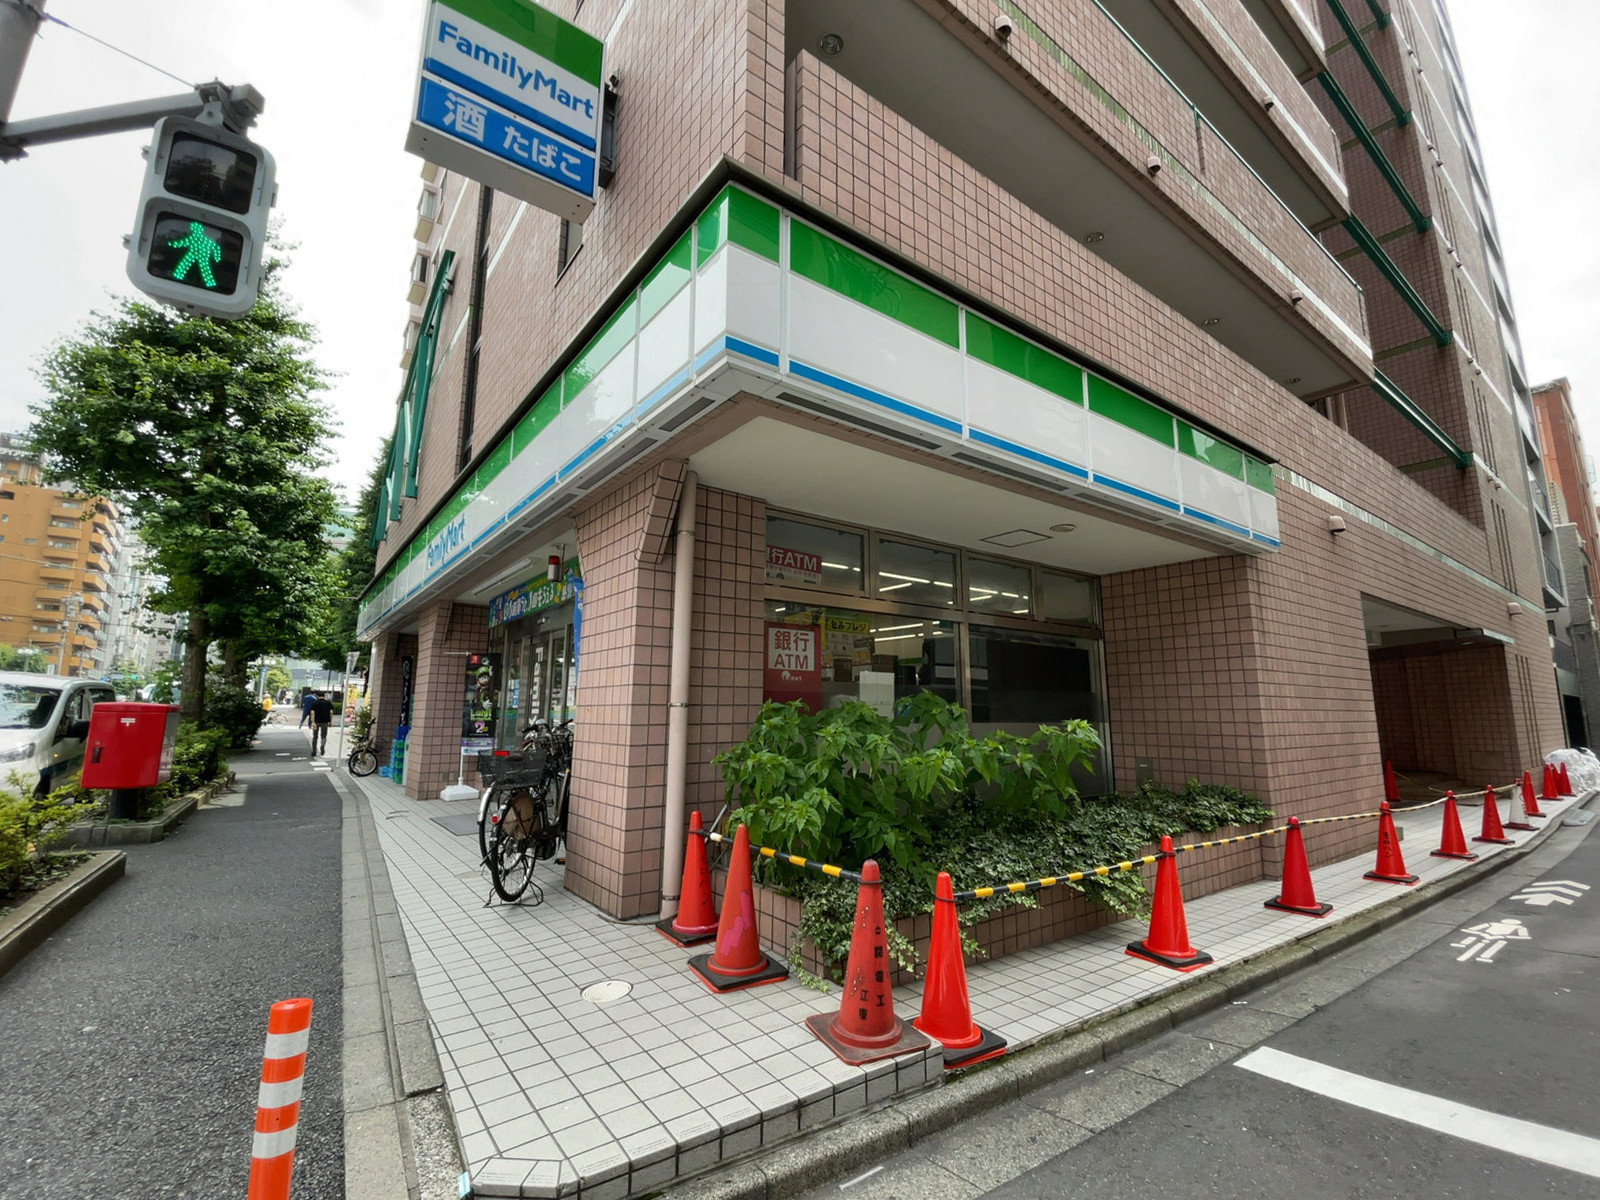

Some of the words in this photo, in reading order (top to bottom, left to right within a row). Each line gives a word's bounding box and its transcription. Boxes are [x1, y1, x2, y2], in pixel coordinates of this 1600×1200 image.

[438, 20, 594, 120] FamilyMart
[442, 91, 488, 142] 酒
[502, 125, 581, 181] たばこ
[427, 513, 465, 570] FamilyMart
[767, 547, 817, 571] 行ATM
[774, 630, 809, 652] 銀行
[774, 653, 809, 670] ATM
